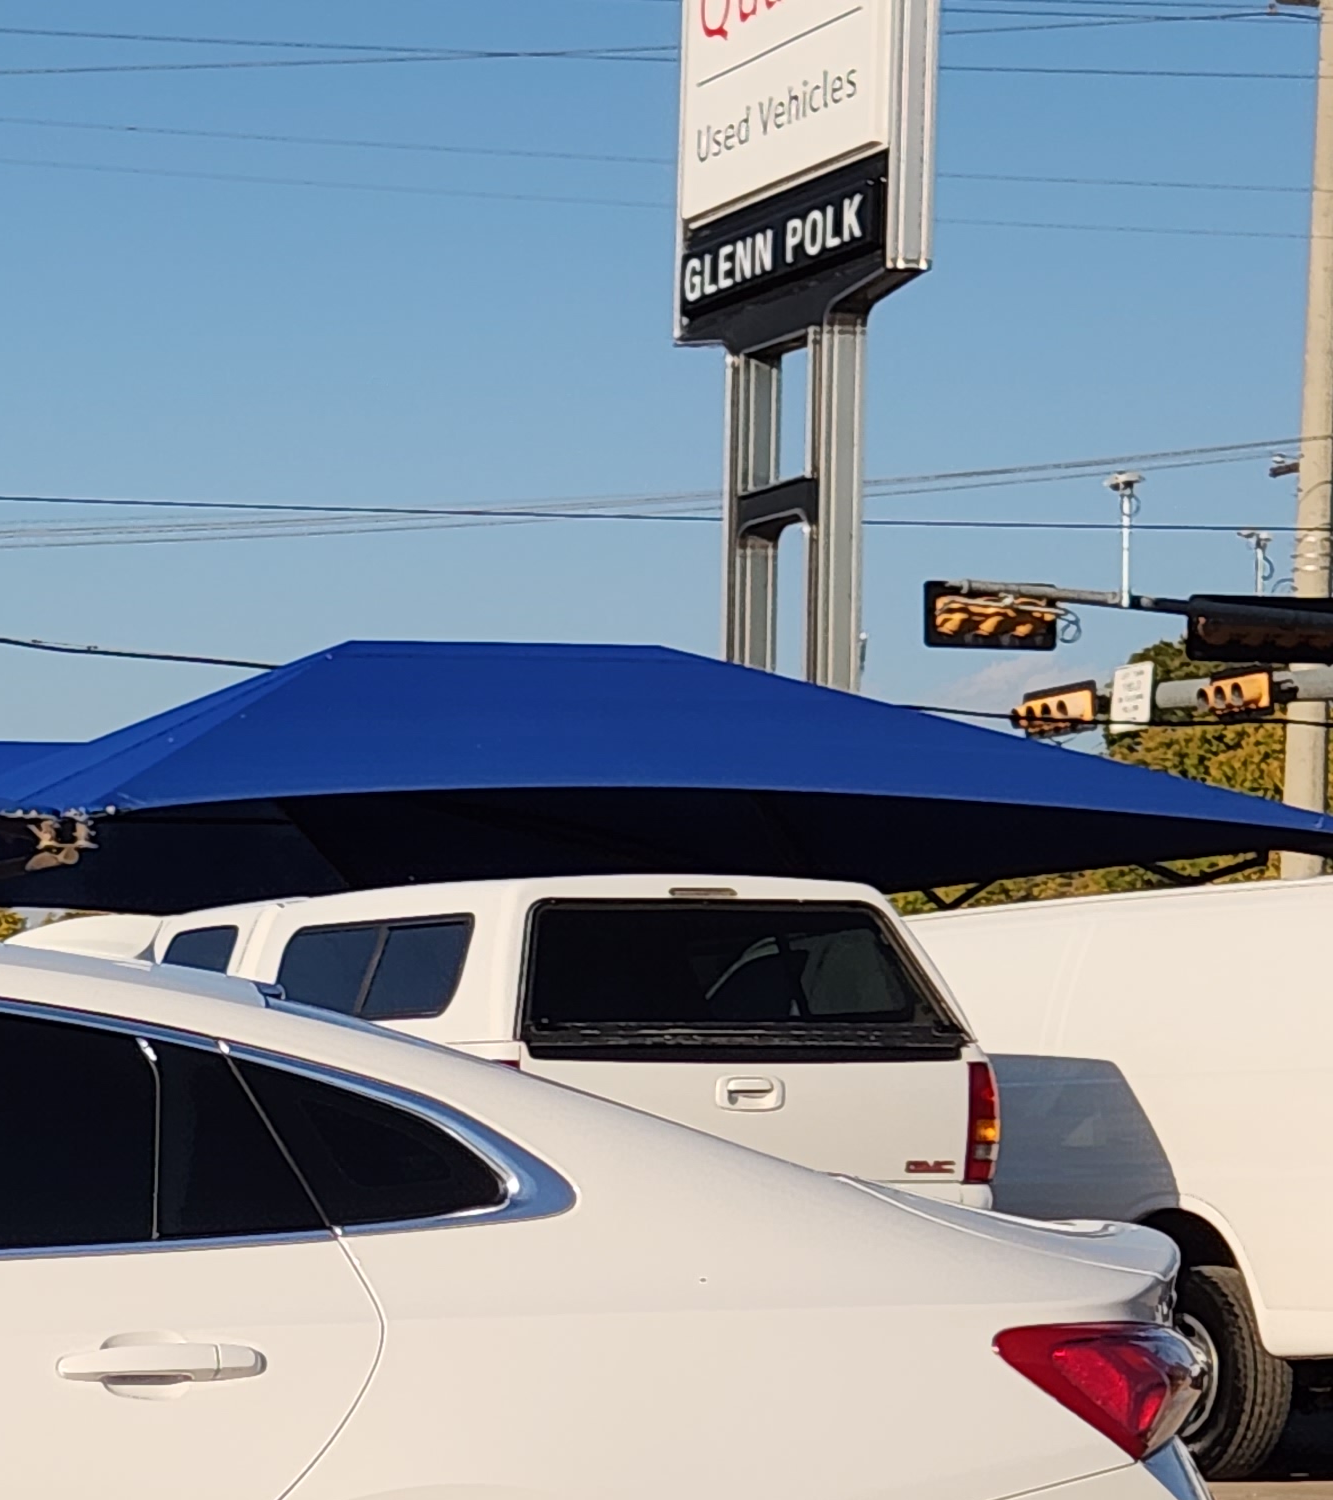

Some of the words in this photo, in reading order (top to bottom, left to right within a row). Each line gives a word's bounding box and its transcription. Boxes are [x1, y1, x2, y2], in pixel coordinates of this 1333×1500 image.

[697, 106, 751, 163] Used
[758, 68, 858, 136] Vehicles
[684, 229, 773, 302] GLENN
[785, 193, 864, 263] POLK
[905, 1160, 956, 1174] GMC
